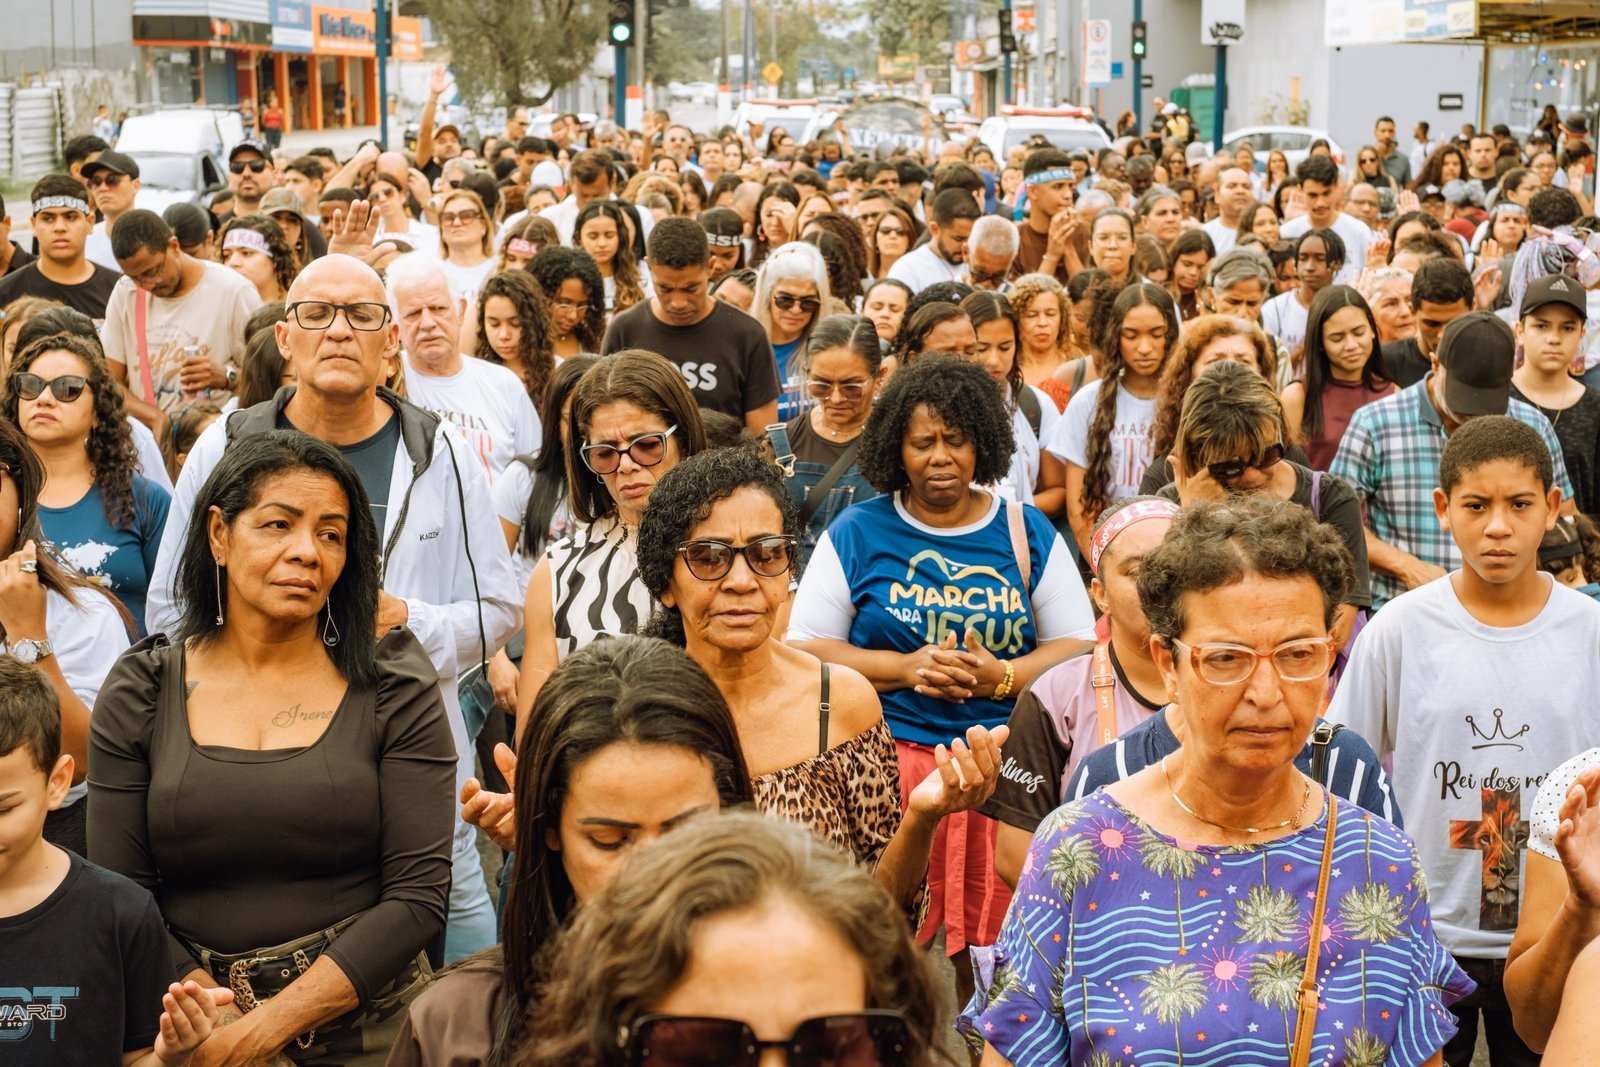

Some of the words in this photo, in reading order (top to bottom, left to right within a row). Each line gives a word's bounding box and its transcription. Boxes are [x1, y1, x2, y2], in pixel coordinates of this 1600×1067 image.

[705, 232, 743, 247] ESU
[1112, 422, 1149, 436] MAR
[890, 582, 1026, 614] MARCHA
[925, 610, 1028, 654] JESUS
[1000, 757, 1046, 794] linas
[1434, 761, 1476, 800] Rei
[1483, 767, 1519, 792] dos
